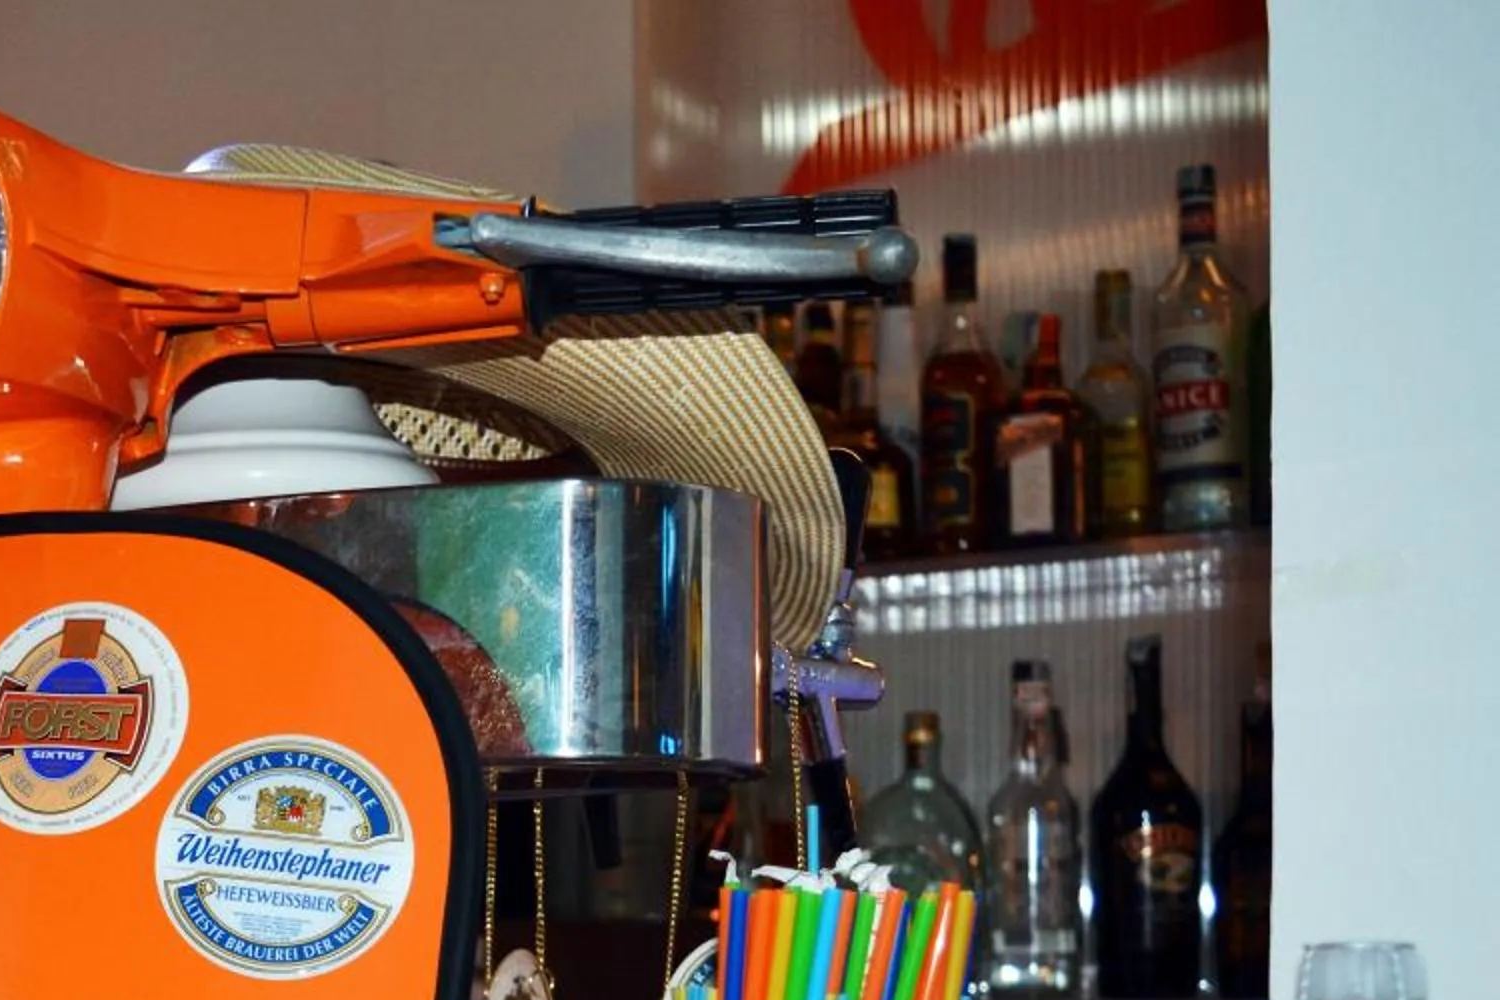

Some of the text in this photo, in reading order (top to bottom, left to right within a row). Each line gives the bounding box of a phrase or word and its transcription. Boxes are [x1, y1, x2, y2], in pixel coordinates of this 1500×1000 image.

[0, 699, 134, 743] FORST
[31, 749, 85, 762] SIXTUS
[206, 751, 378, 811] BIRRA SPECIALE
[177, 832, 391, 886] Weihenstephaner
[216, 884, 337, 914] HEFEWEISSBIER
[224, 936, 299, 962] BRAUEREI
[303, 938, 334, 959] DER
[335, 913, 370, 946] WELT
